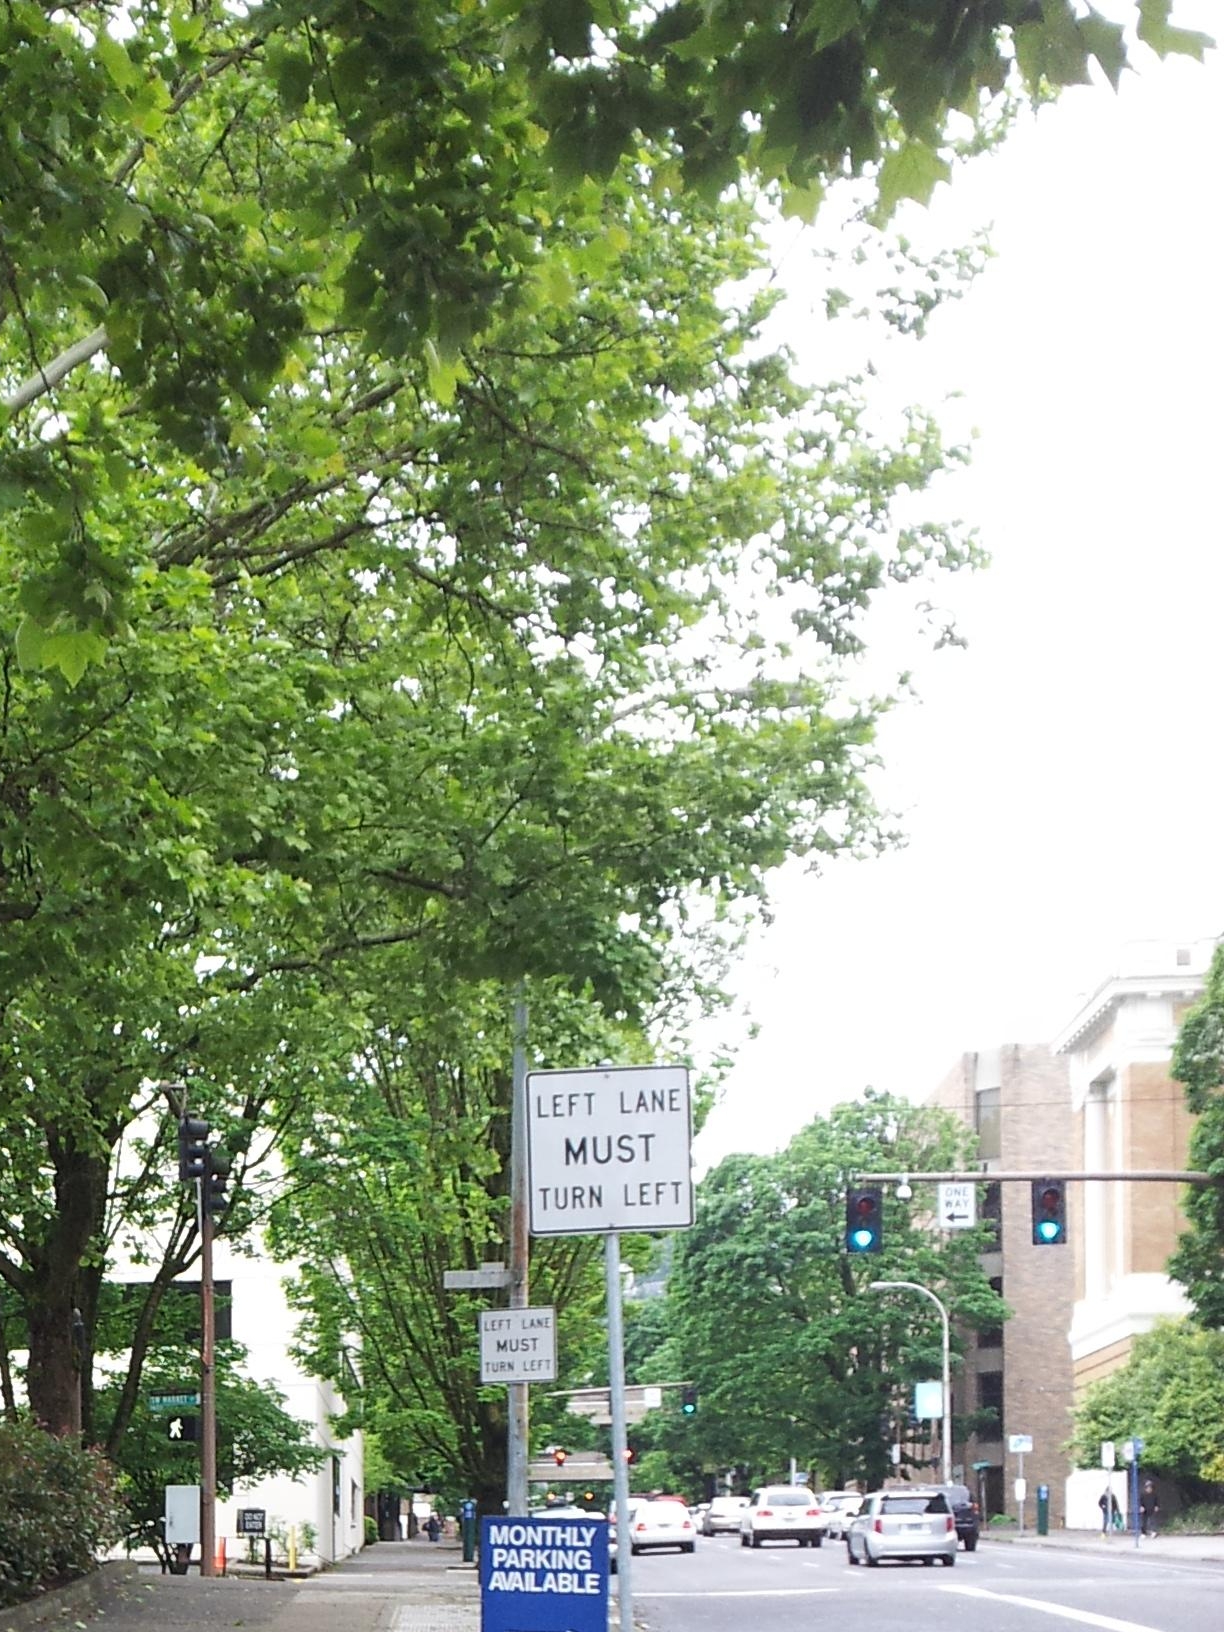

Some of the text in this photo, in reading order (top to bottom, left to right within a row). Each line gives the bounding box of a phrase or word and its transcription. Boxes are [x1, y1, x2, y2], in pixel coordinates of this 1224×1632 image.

[537, 1088, 681, 1118] LEFT LANE
[565, 1133, 655, 1166] MUST
[539, 1181, 683, 1211] TURN LEFT
[945, 1186, 968, 1197] ONE
[484, 1317, 551, 1332] LEFT LANE
[496, 1338, 539, 1353] MUST
[485, 1359, 551, 1373] TURN LEFT
[489, 1525, 597, 1547] MONTHLY
[492, 1548, 592, 1570] PARKING
[488, 1571, 601, 1594] AVAILABLE
